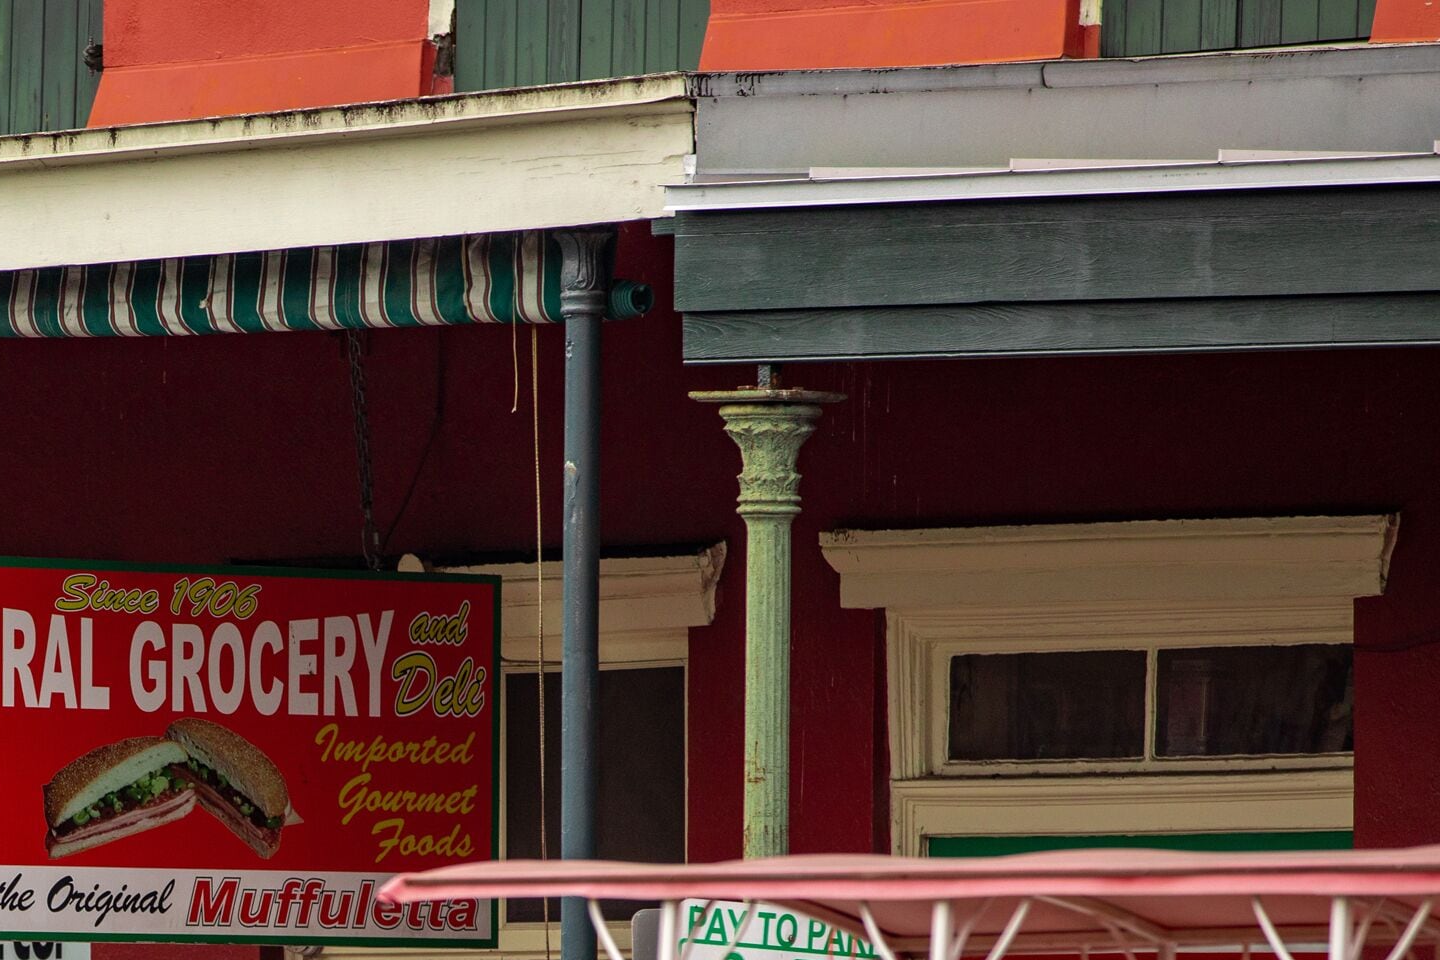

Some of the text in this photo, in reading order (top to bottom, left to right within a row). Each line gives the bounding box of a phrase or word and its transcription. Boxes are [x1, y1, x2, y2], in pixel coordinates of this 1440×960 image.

[55, 573, 262, 619] Since 1906
[408, 599, 471, 647] and
[129, 609, 395, 718] GROCERY
[392, 650, 486, 718] Deli
[314, 723, 477, 773] Imported
[338, 772, 479, 826] Gourmet
[371, 818, 476, 864] Foods
[47, 875, 177, 927] Original
[185, 876, 479, 932] Muffuletta
[688, 905, 749, 944] PAY
[757, 911, 799, 948] TO
